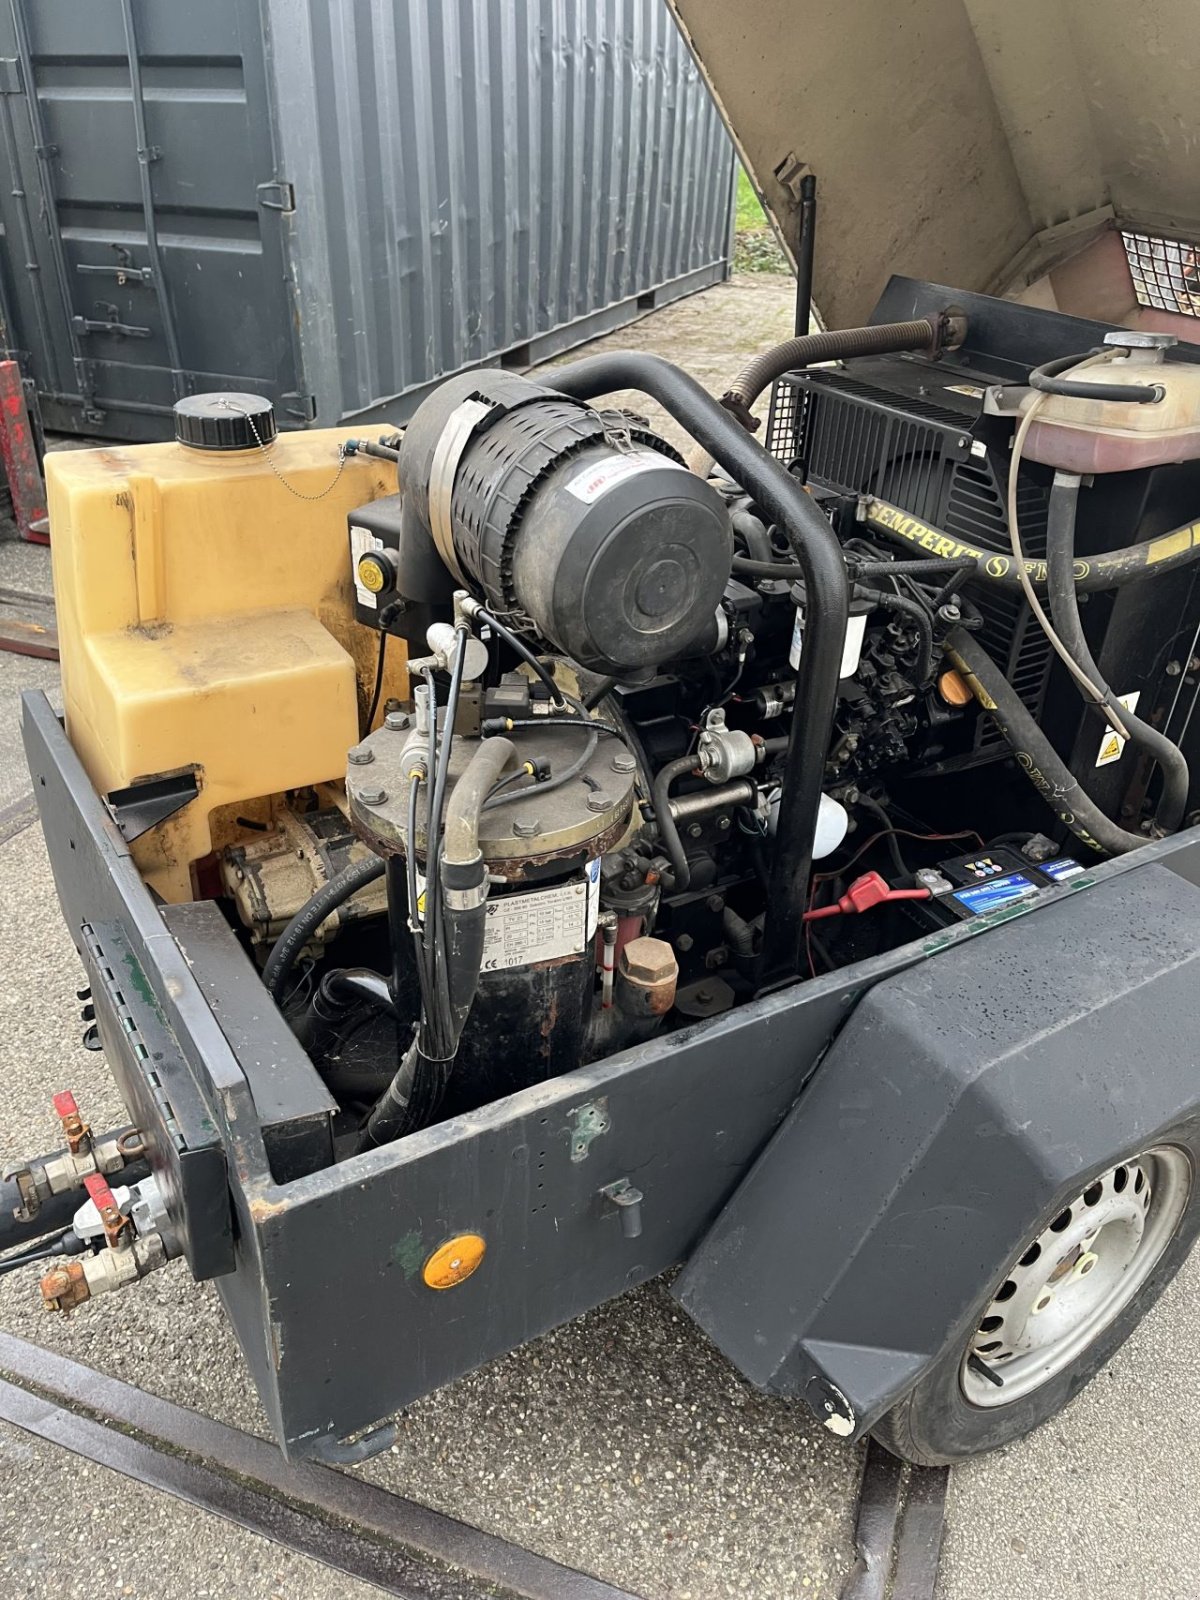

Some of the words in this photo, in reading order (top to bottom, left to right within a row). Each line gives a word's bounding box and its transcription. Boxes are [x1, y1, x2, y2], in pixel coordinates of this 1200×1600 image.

[346, 868, 361, 882] ISO
[301, 911, 314, 925] DN
[504, 956, 523, 967] 1017
